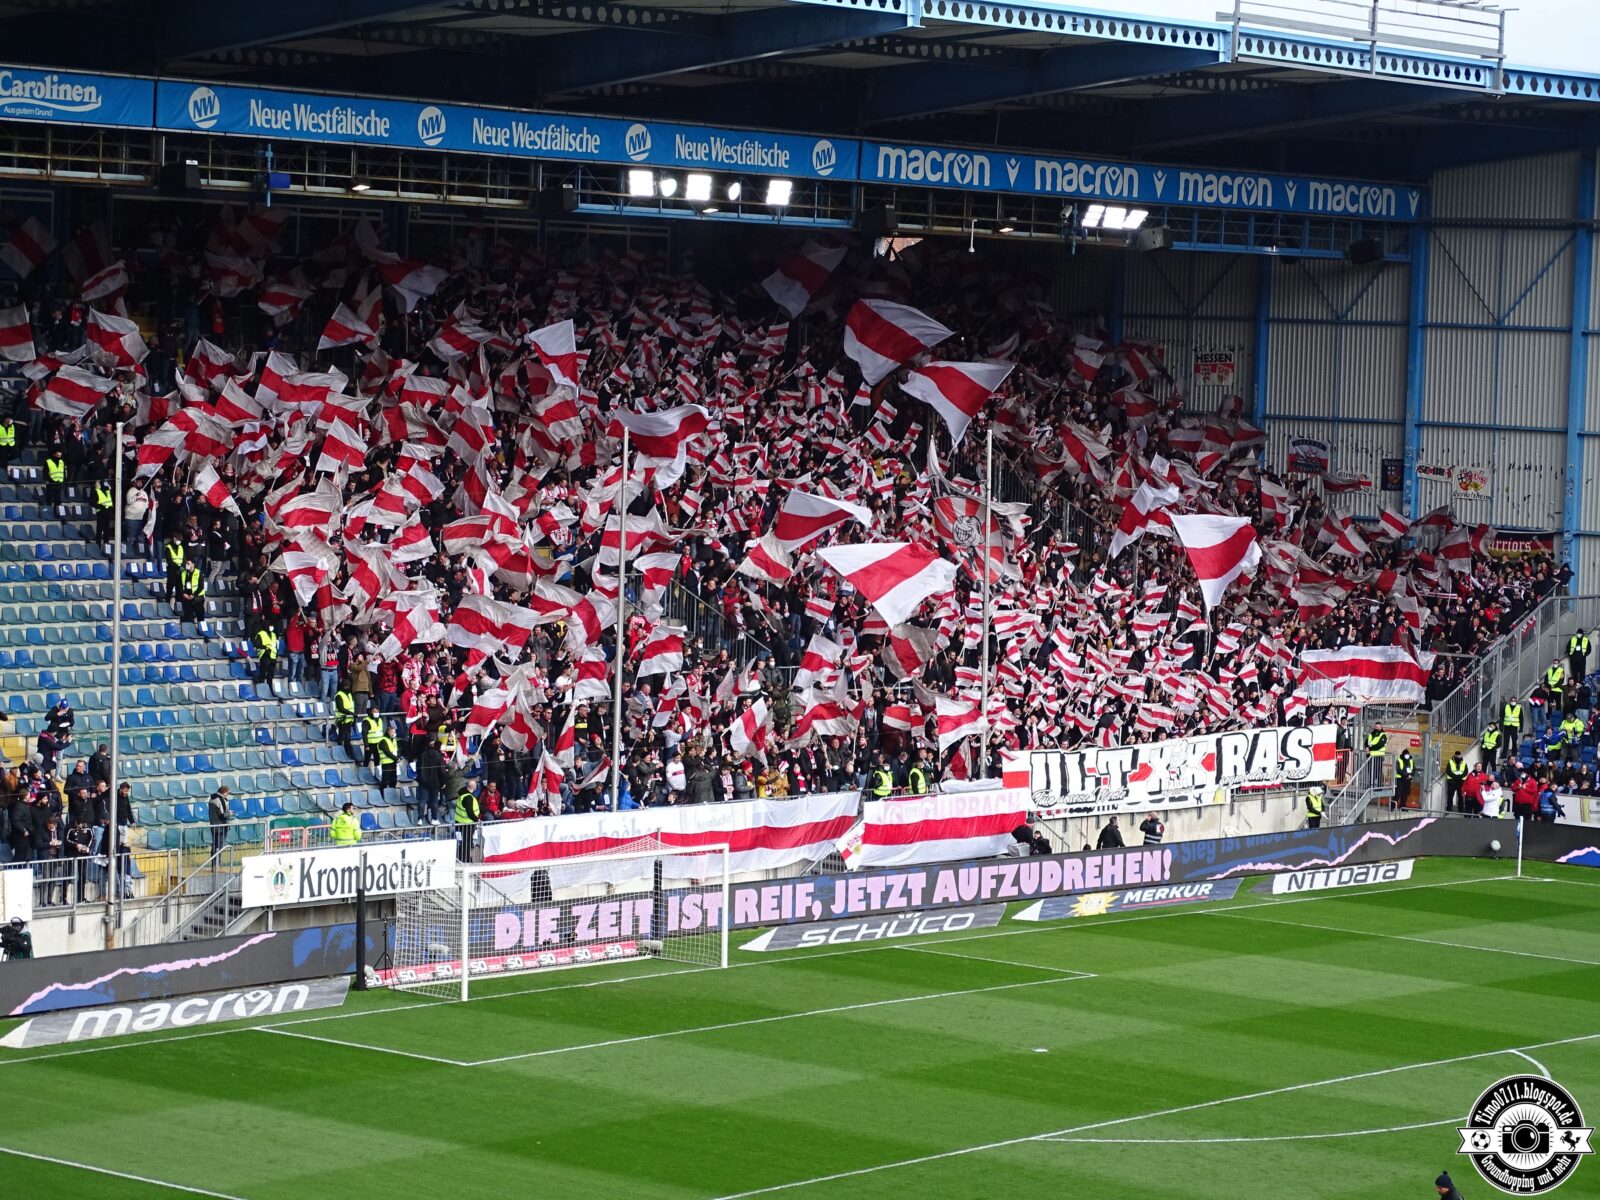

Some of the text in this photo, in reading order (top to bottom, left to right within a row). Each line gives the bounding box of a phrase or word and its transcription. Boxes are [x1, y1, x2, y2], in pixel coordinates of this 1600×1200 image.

[0, 71, 97, 103] Carolinen
[250, 99, 390, 138] Neue Westfälische
[472, 117, 600, 153] Neue Westfälische
[676, 134, 790, 168] Neue Westfälische
[877, 146, 990, 186] macron
[1035, 160, 1138, 198] macron
[1179, 172, 1272, 207] macron
[1310, 181, 1395, 216] macron
[1195, 353, 1232, 363] HESSEN
[300, 851, 437, 898] Krombacher
[1287, 870, 1337, 890] NTT
[495, 849, 1173, 950] DIE ZEIT IST REIF, JETZT AUFZUDREHEN!
[1123, 883, 1214, 904] MERKUR
[797, 912, 976, 947] SCHÜCO
[67, 984, 310, 1042] macron
